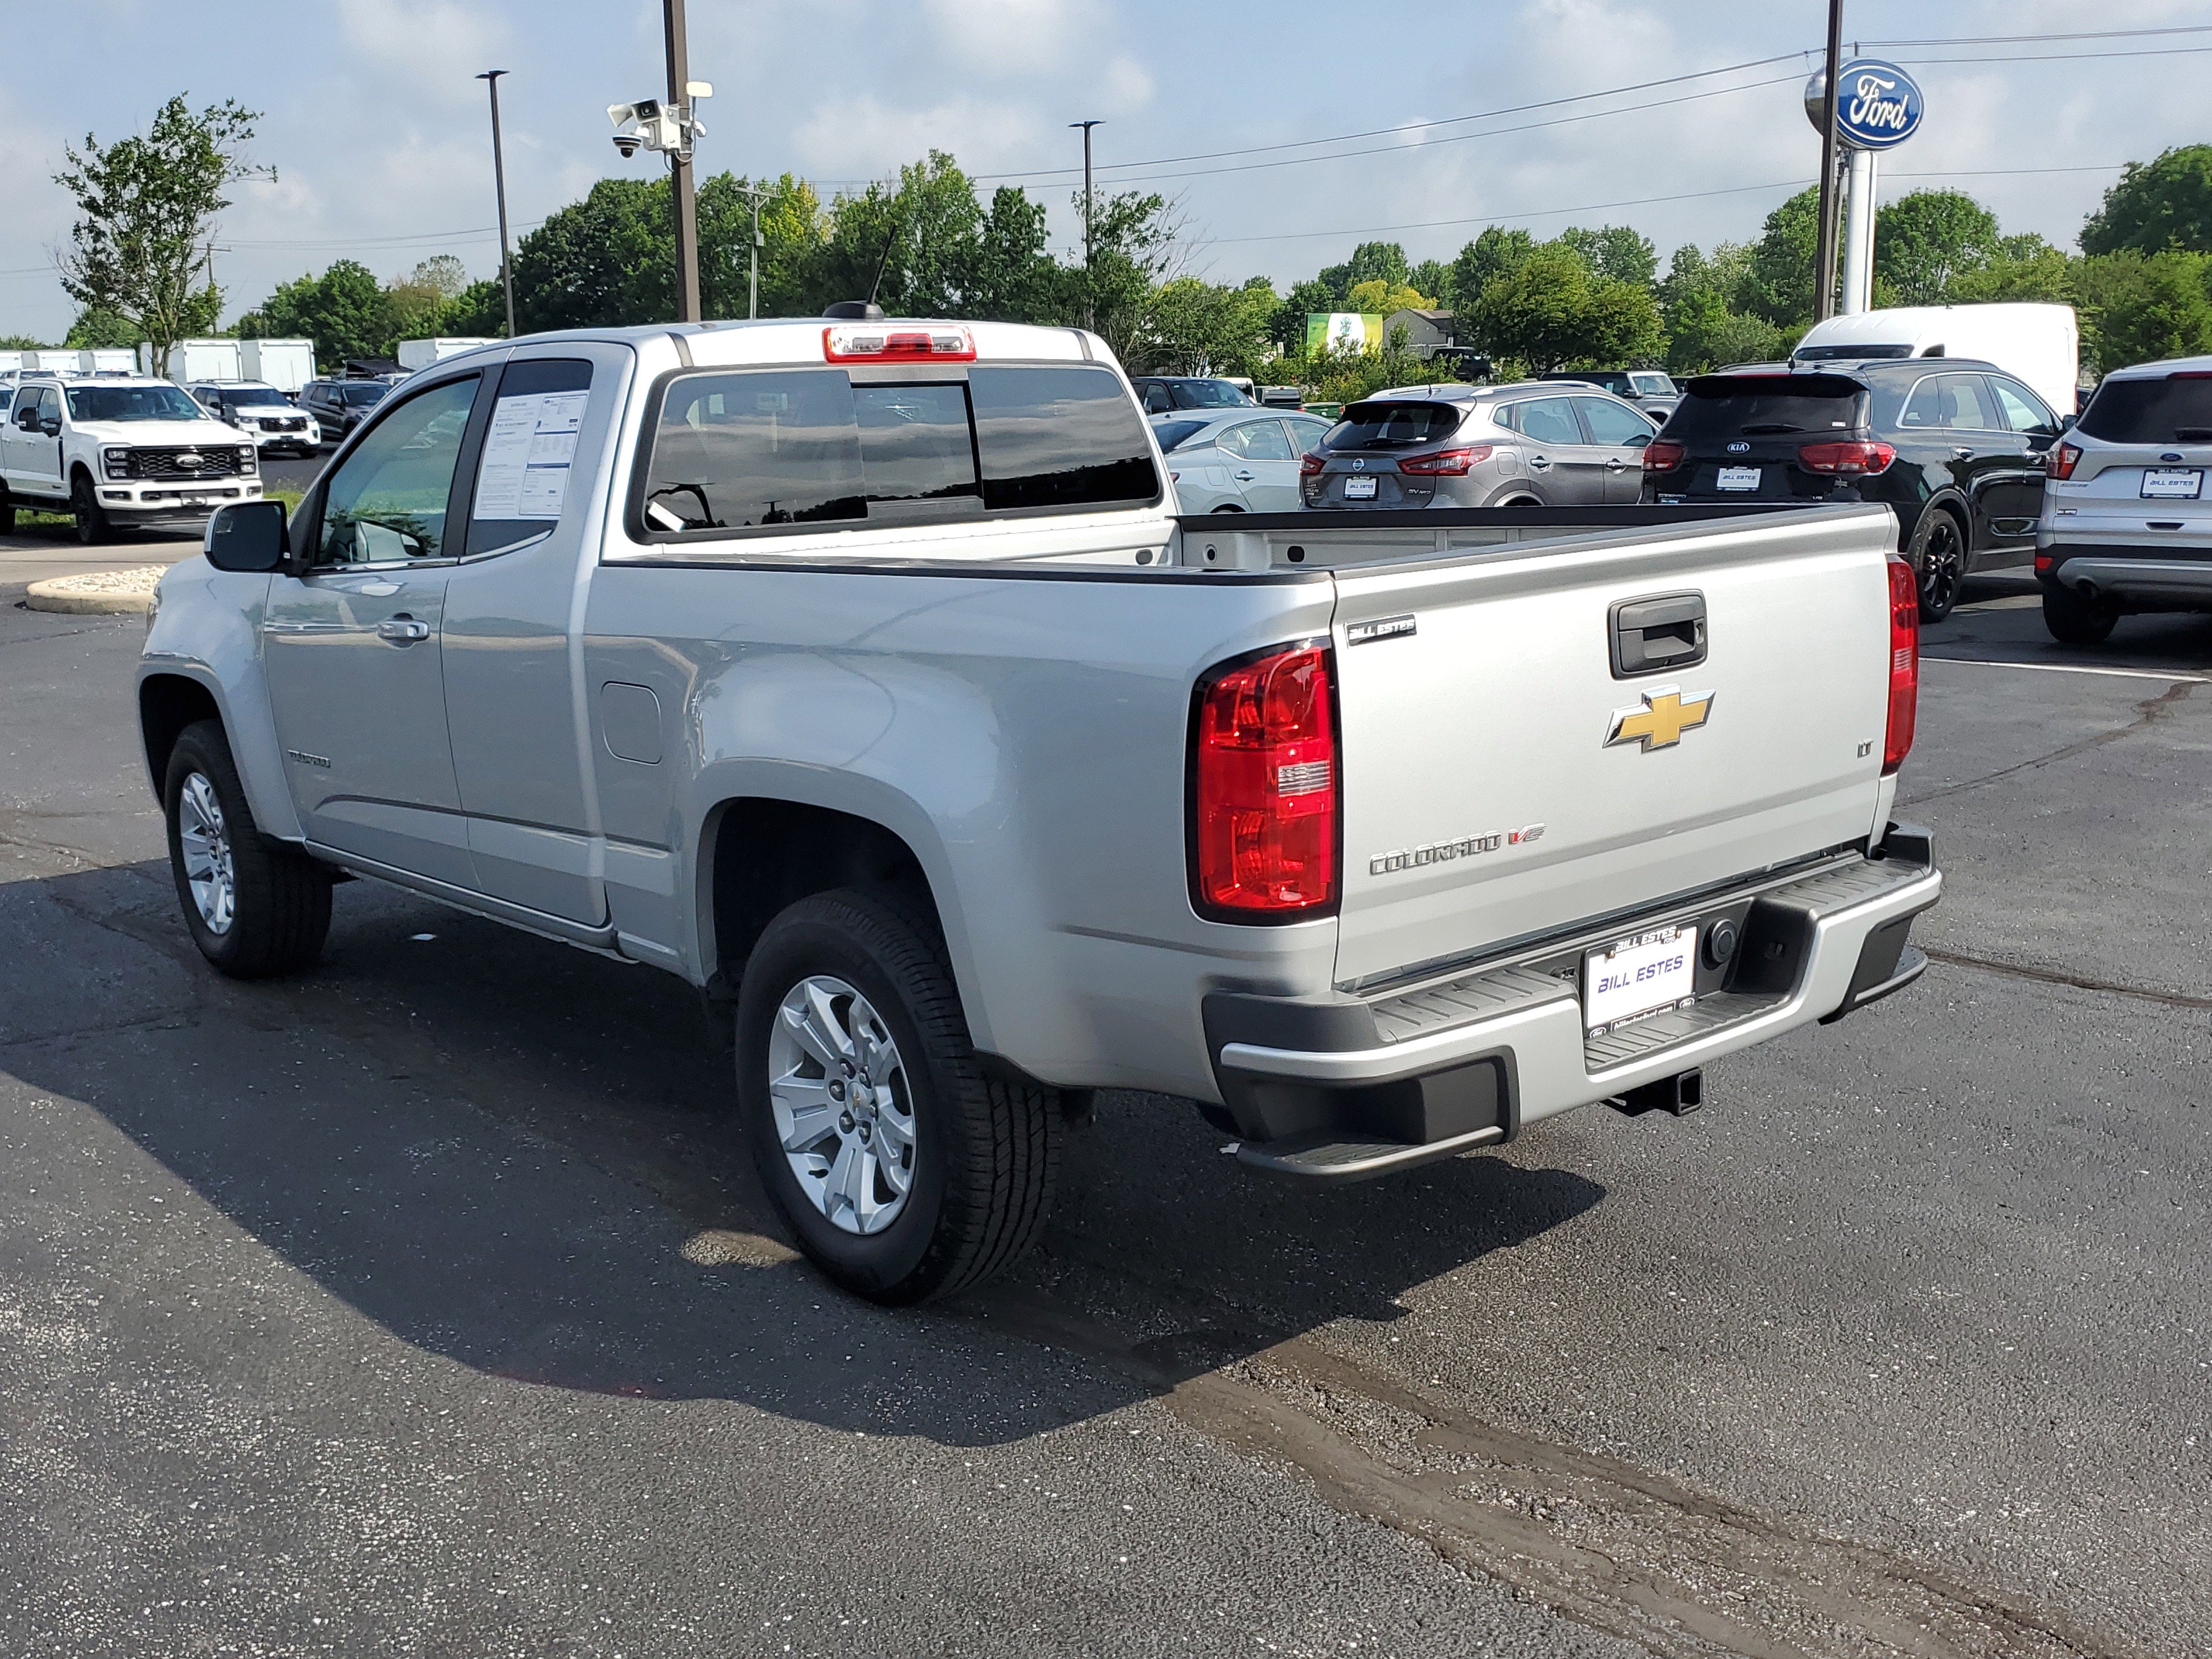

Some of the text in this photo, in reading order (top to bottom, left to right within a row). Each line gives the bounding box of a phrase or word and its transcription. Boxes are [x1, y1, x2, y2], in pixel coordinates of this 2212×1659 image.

[1850, 75, 1909, 130] Ford
[1377, 618, 1416, 635] ESTES
[1857, 738, 1874, 759] LT
[1369, 822, 1547, 876] COLORADO V6
[1616, 926, 1677, 953] BILL ESTES
[1598, 955, 1684, 994] BILL ESTES
